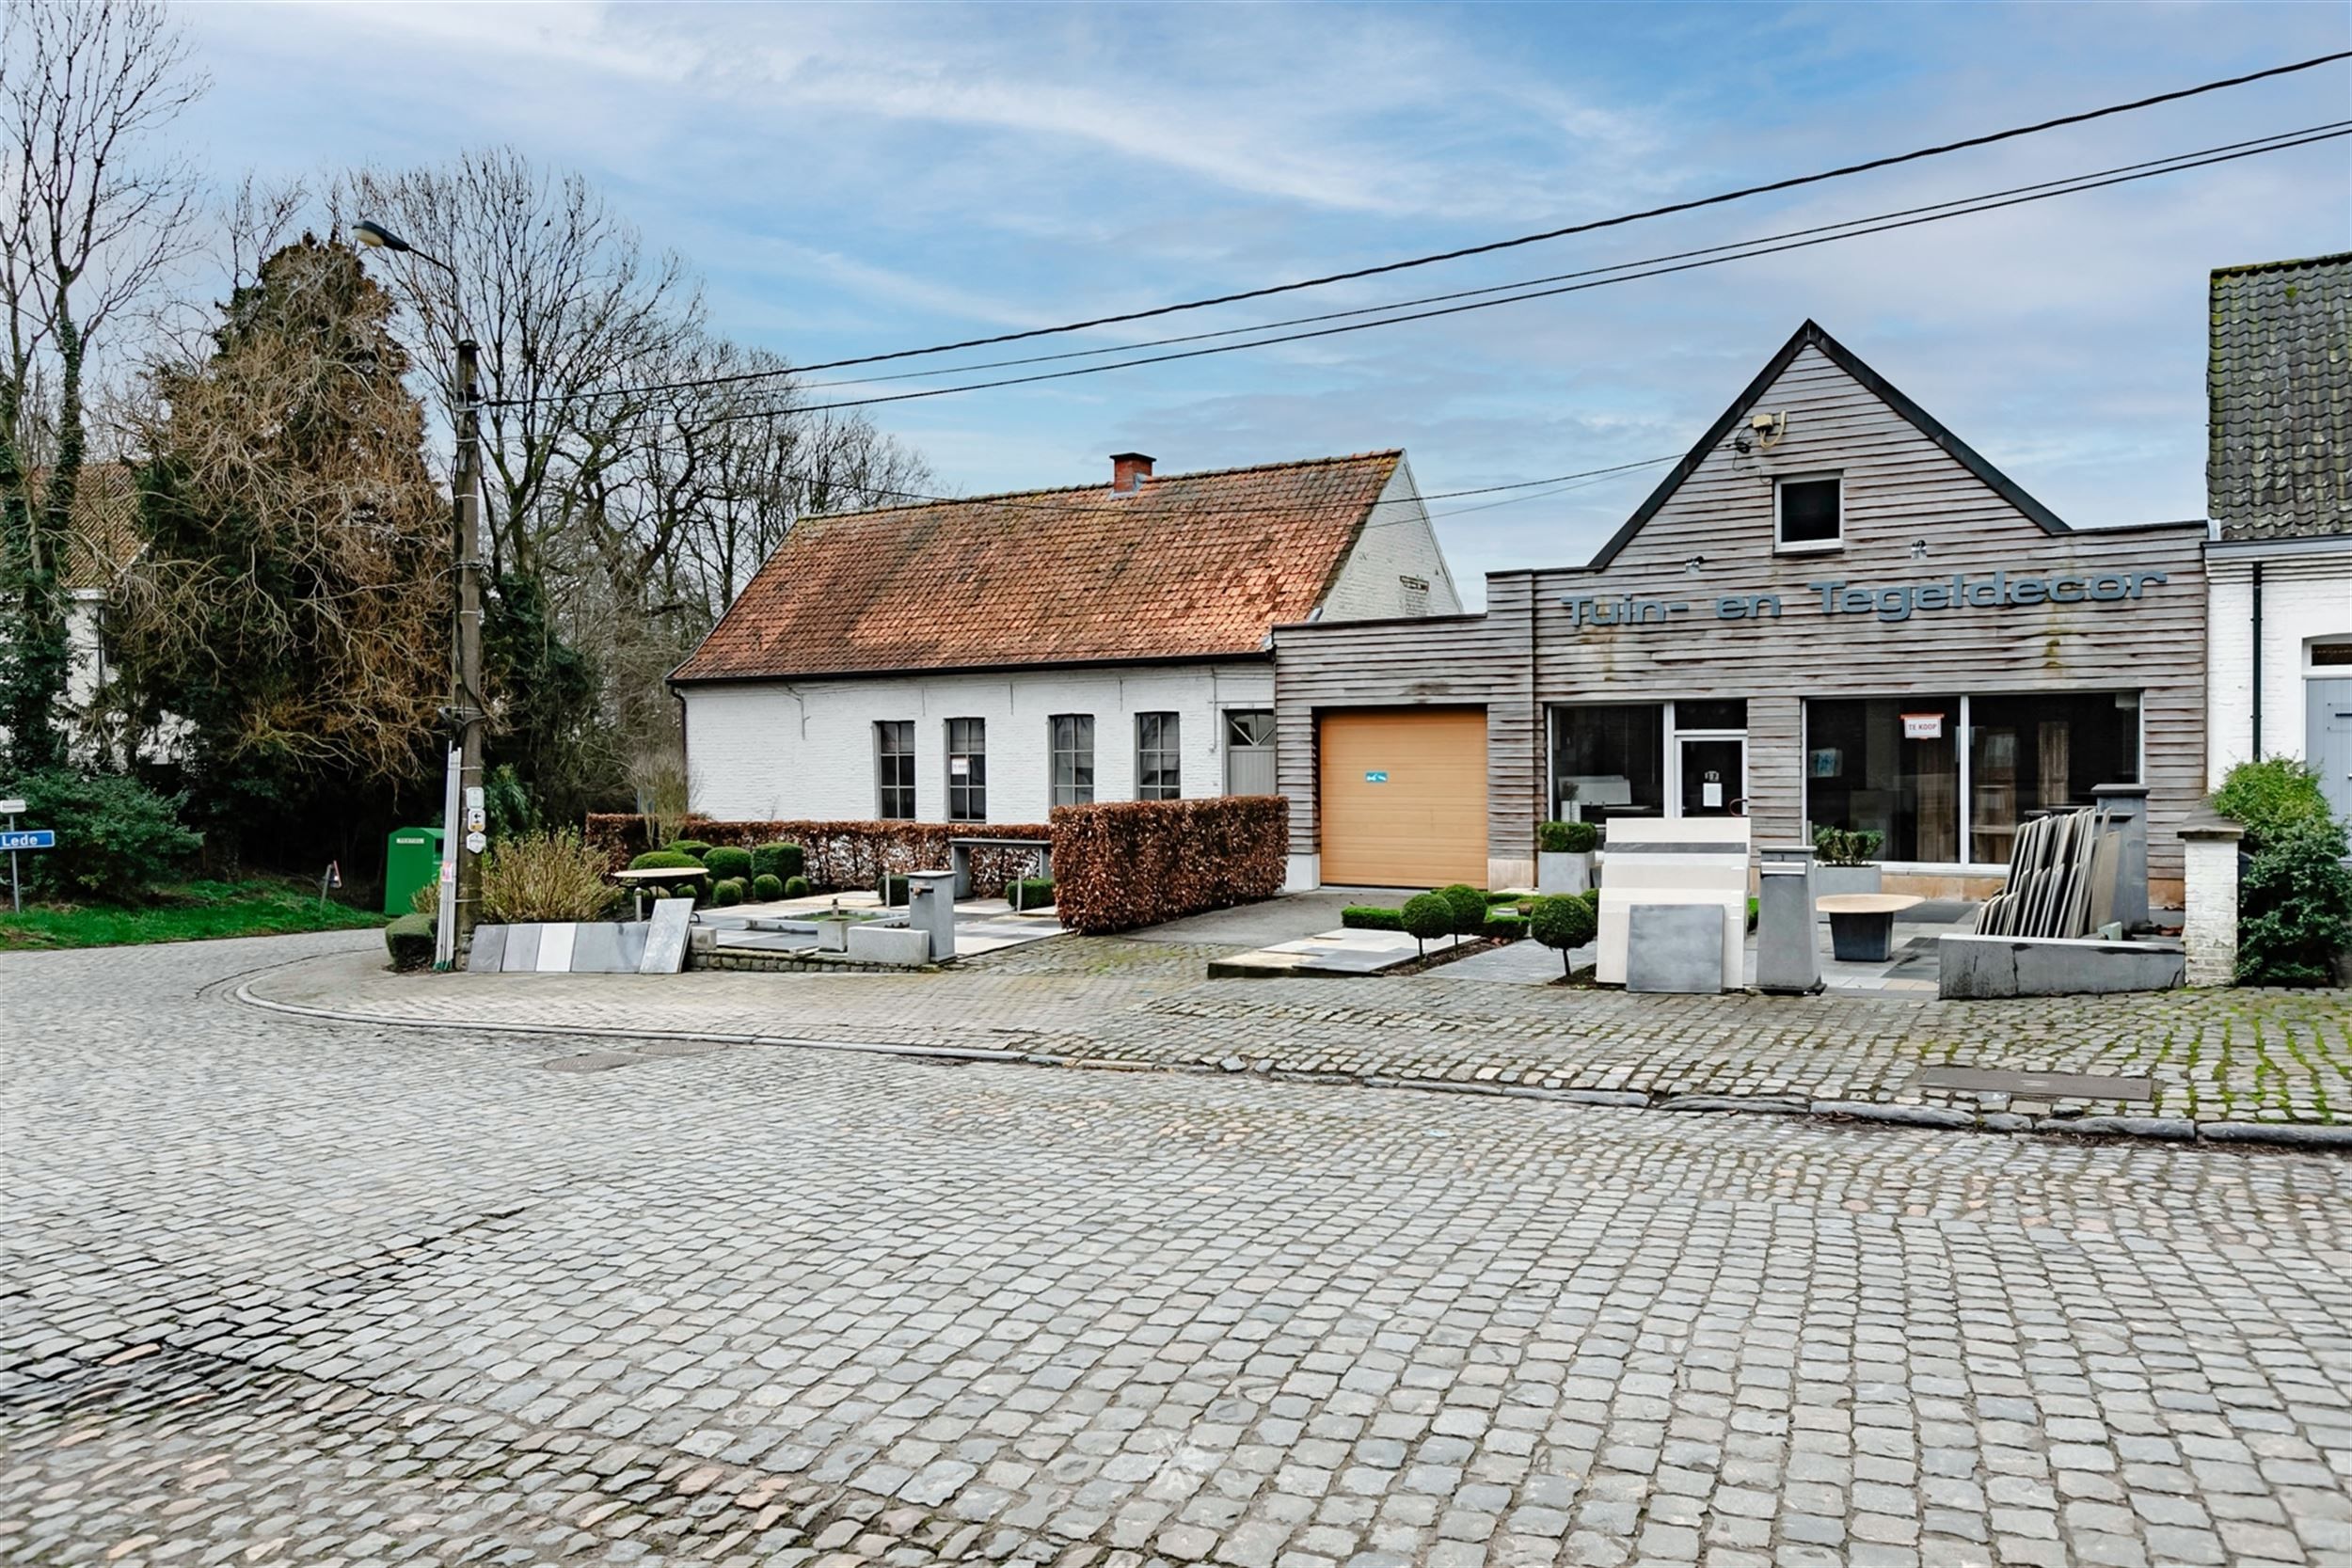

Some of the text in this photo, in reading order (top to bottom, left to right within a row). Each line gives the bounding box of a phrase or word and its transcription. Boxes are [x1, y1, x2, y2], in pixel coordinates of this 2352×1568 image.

[1561, 571, 2168, 626] Tuin- en Tegeldecor
[2, 834, 39, 847] Lede
